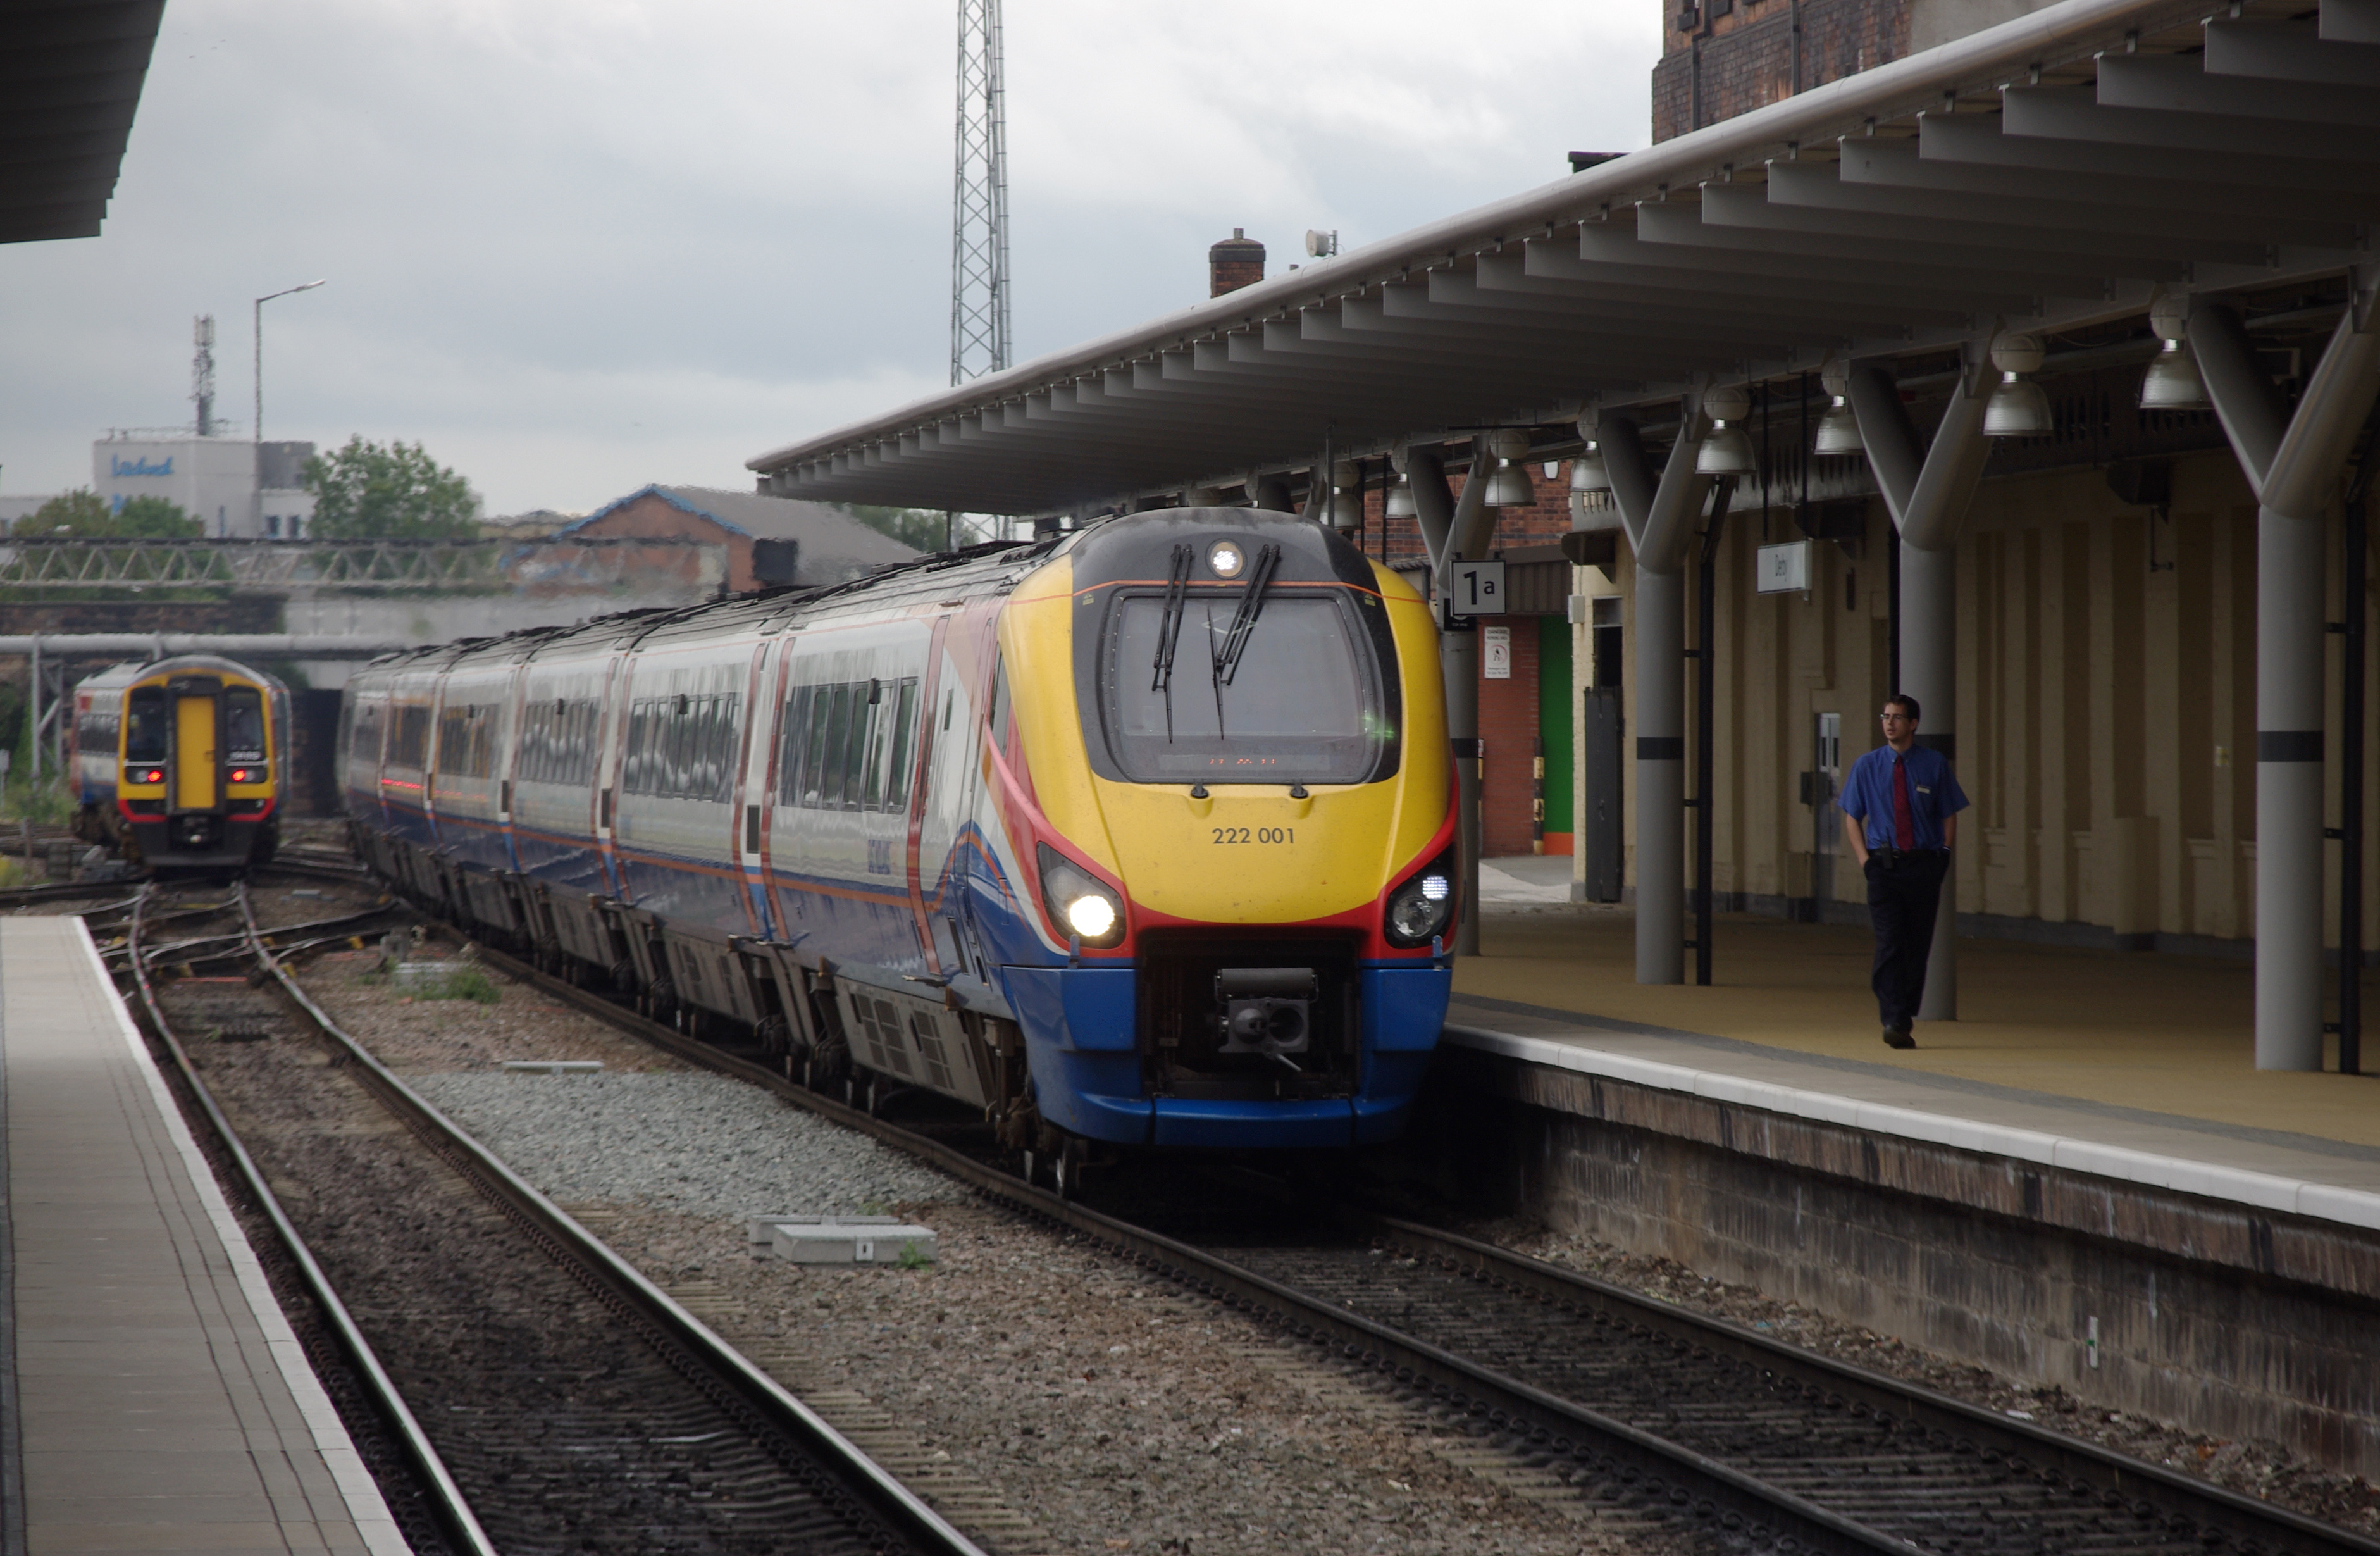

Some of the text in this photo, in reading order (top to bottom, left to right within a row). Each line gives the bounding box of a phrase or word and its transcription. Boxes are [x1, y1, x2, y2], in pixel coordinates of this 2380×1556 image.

[1463, 571, 1495, 605] 1a
[1212, 827, 1294, 843] 222 001
